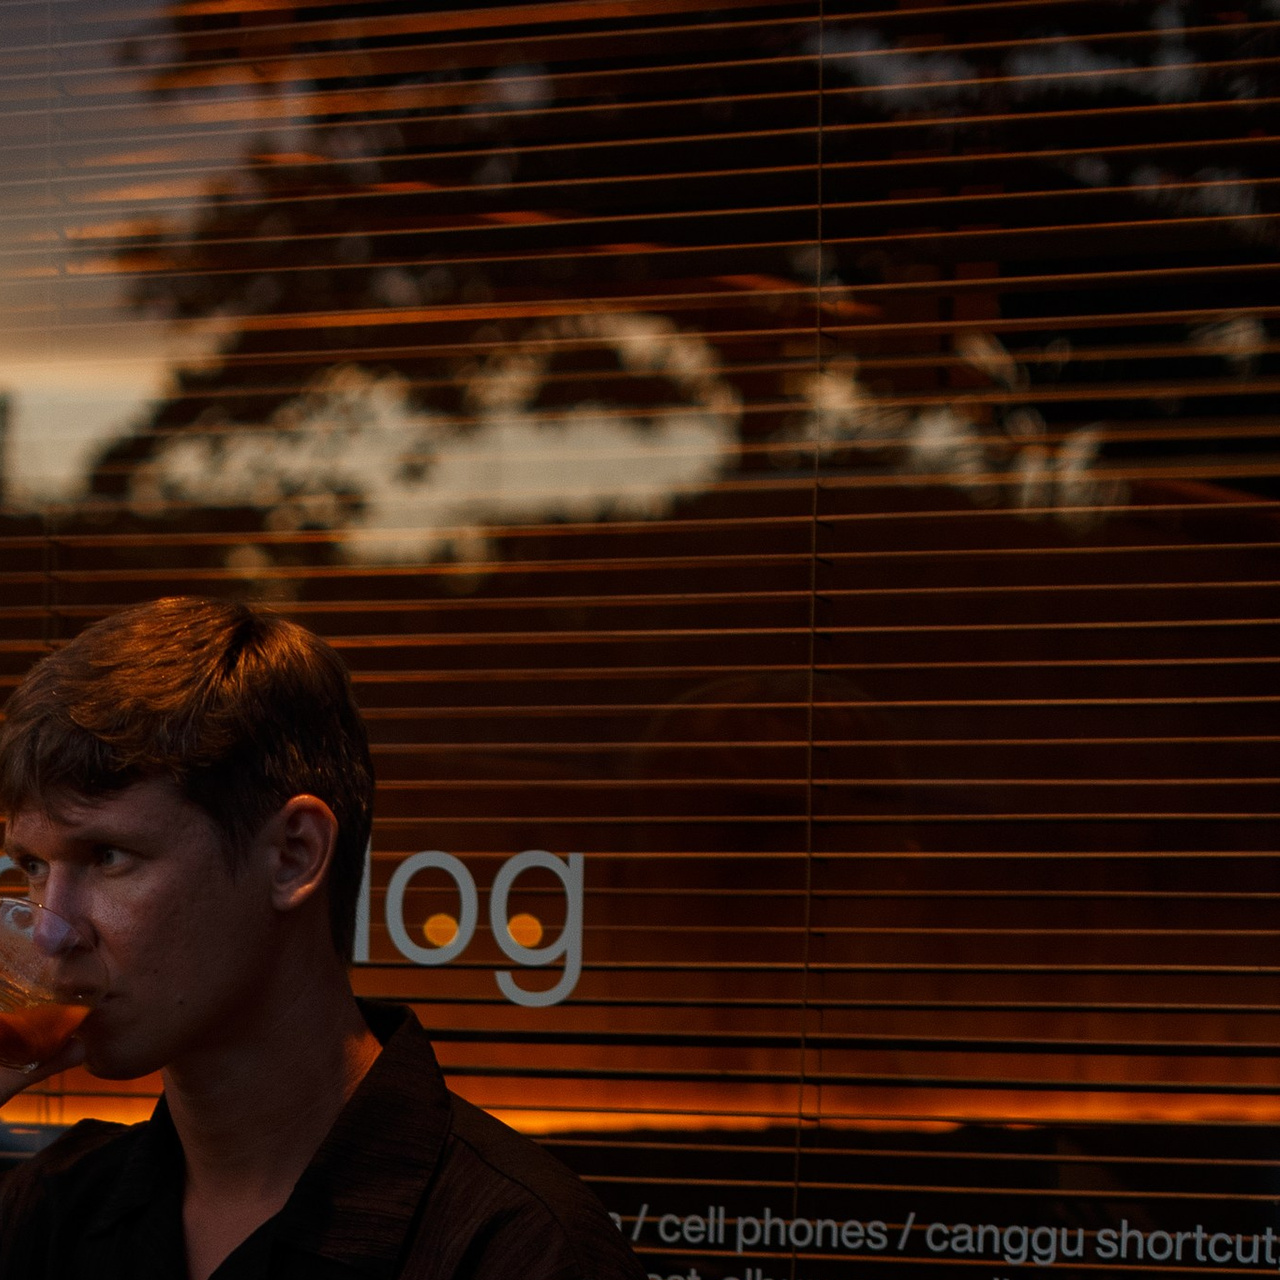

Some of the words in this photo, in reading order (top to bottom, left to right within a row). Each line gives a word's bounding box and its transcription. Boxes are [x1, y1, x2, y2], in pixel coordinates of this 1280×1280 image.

[658, 1205, 726, 1245] cell
[736, 1207, 889, 1255] phones
[925, 1221, 1085, 1267] canggu
[1095, 1219, 1280, 1270] shortcut
